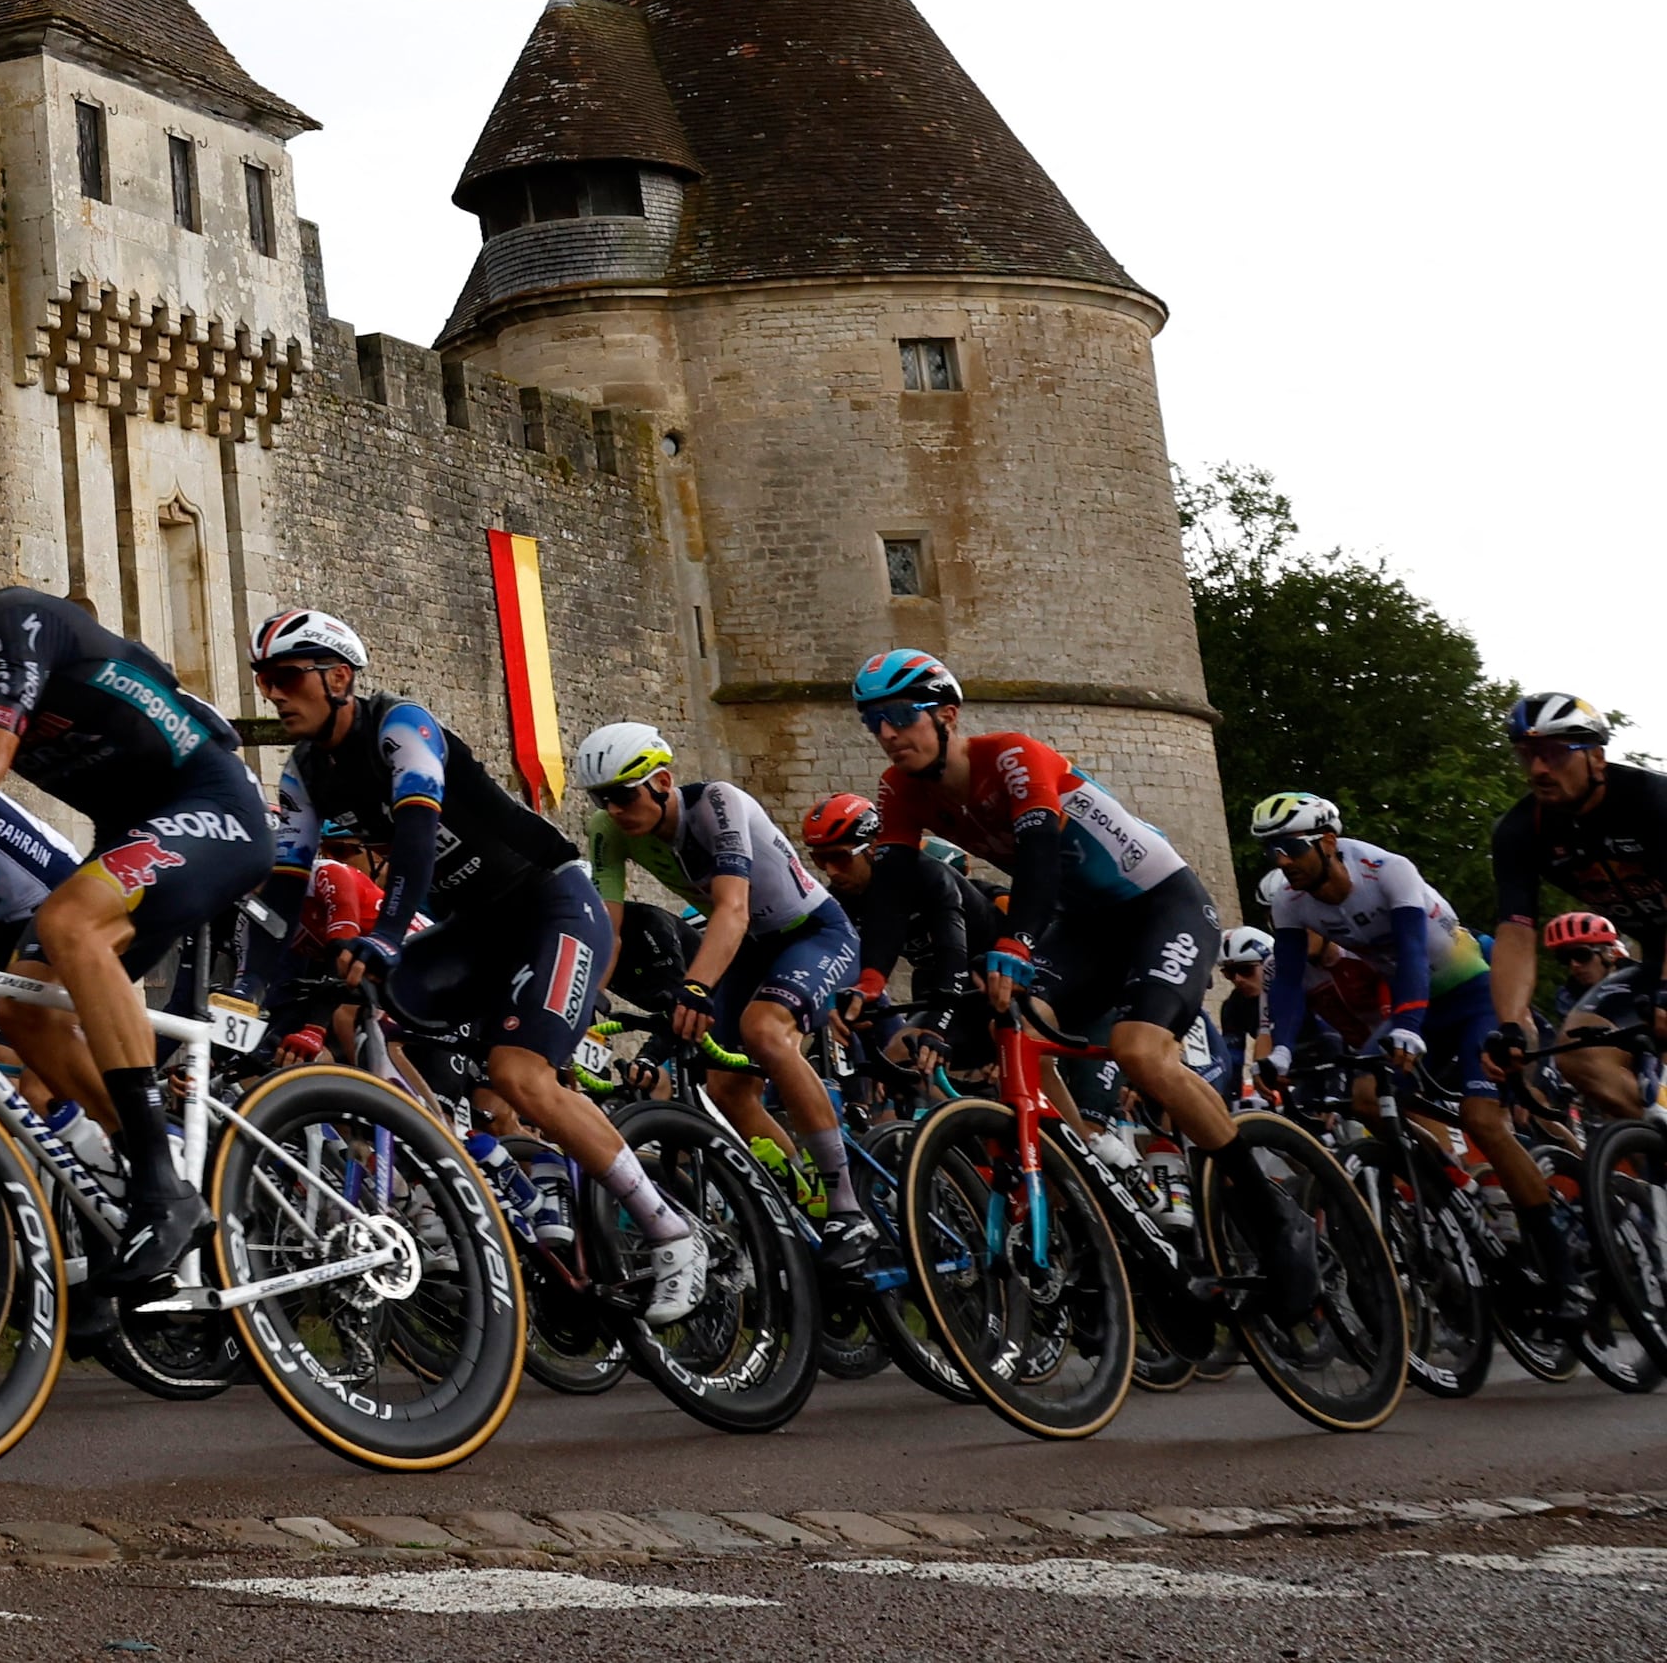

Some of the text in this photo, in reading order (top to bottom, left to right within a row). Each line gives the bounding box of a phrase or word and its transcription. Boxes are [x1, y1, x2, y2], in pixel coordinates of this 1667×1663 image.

[301, 628, 362, 662] SPECIALIZED
[19, 660, 39, 712] BORA
[95, 662, 202, 759] hansgrohe
[145, 811, 253, 842] BORA
[1088, 808, 1130, 848] SOLAR
[565, 946, 593, 1029] SOUDAL
[811, 943, 857, 1014] FANTINI
[817, 954, 833, 971] VINI
[223, 1017, 251, 1047] 87
[583, 1041, 601, 1070] 73
[1095, 1059, 1121, 1092] Jay
[709, 1135, 796, 1240] roval
[1058, 1121, 1179, 1271] ORBEA
[436, 1155, 514, 1310] roval
[4, 1180, 55, 1351] roval
